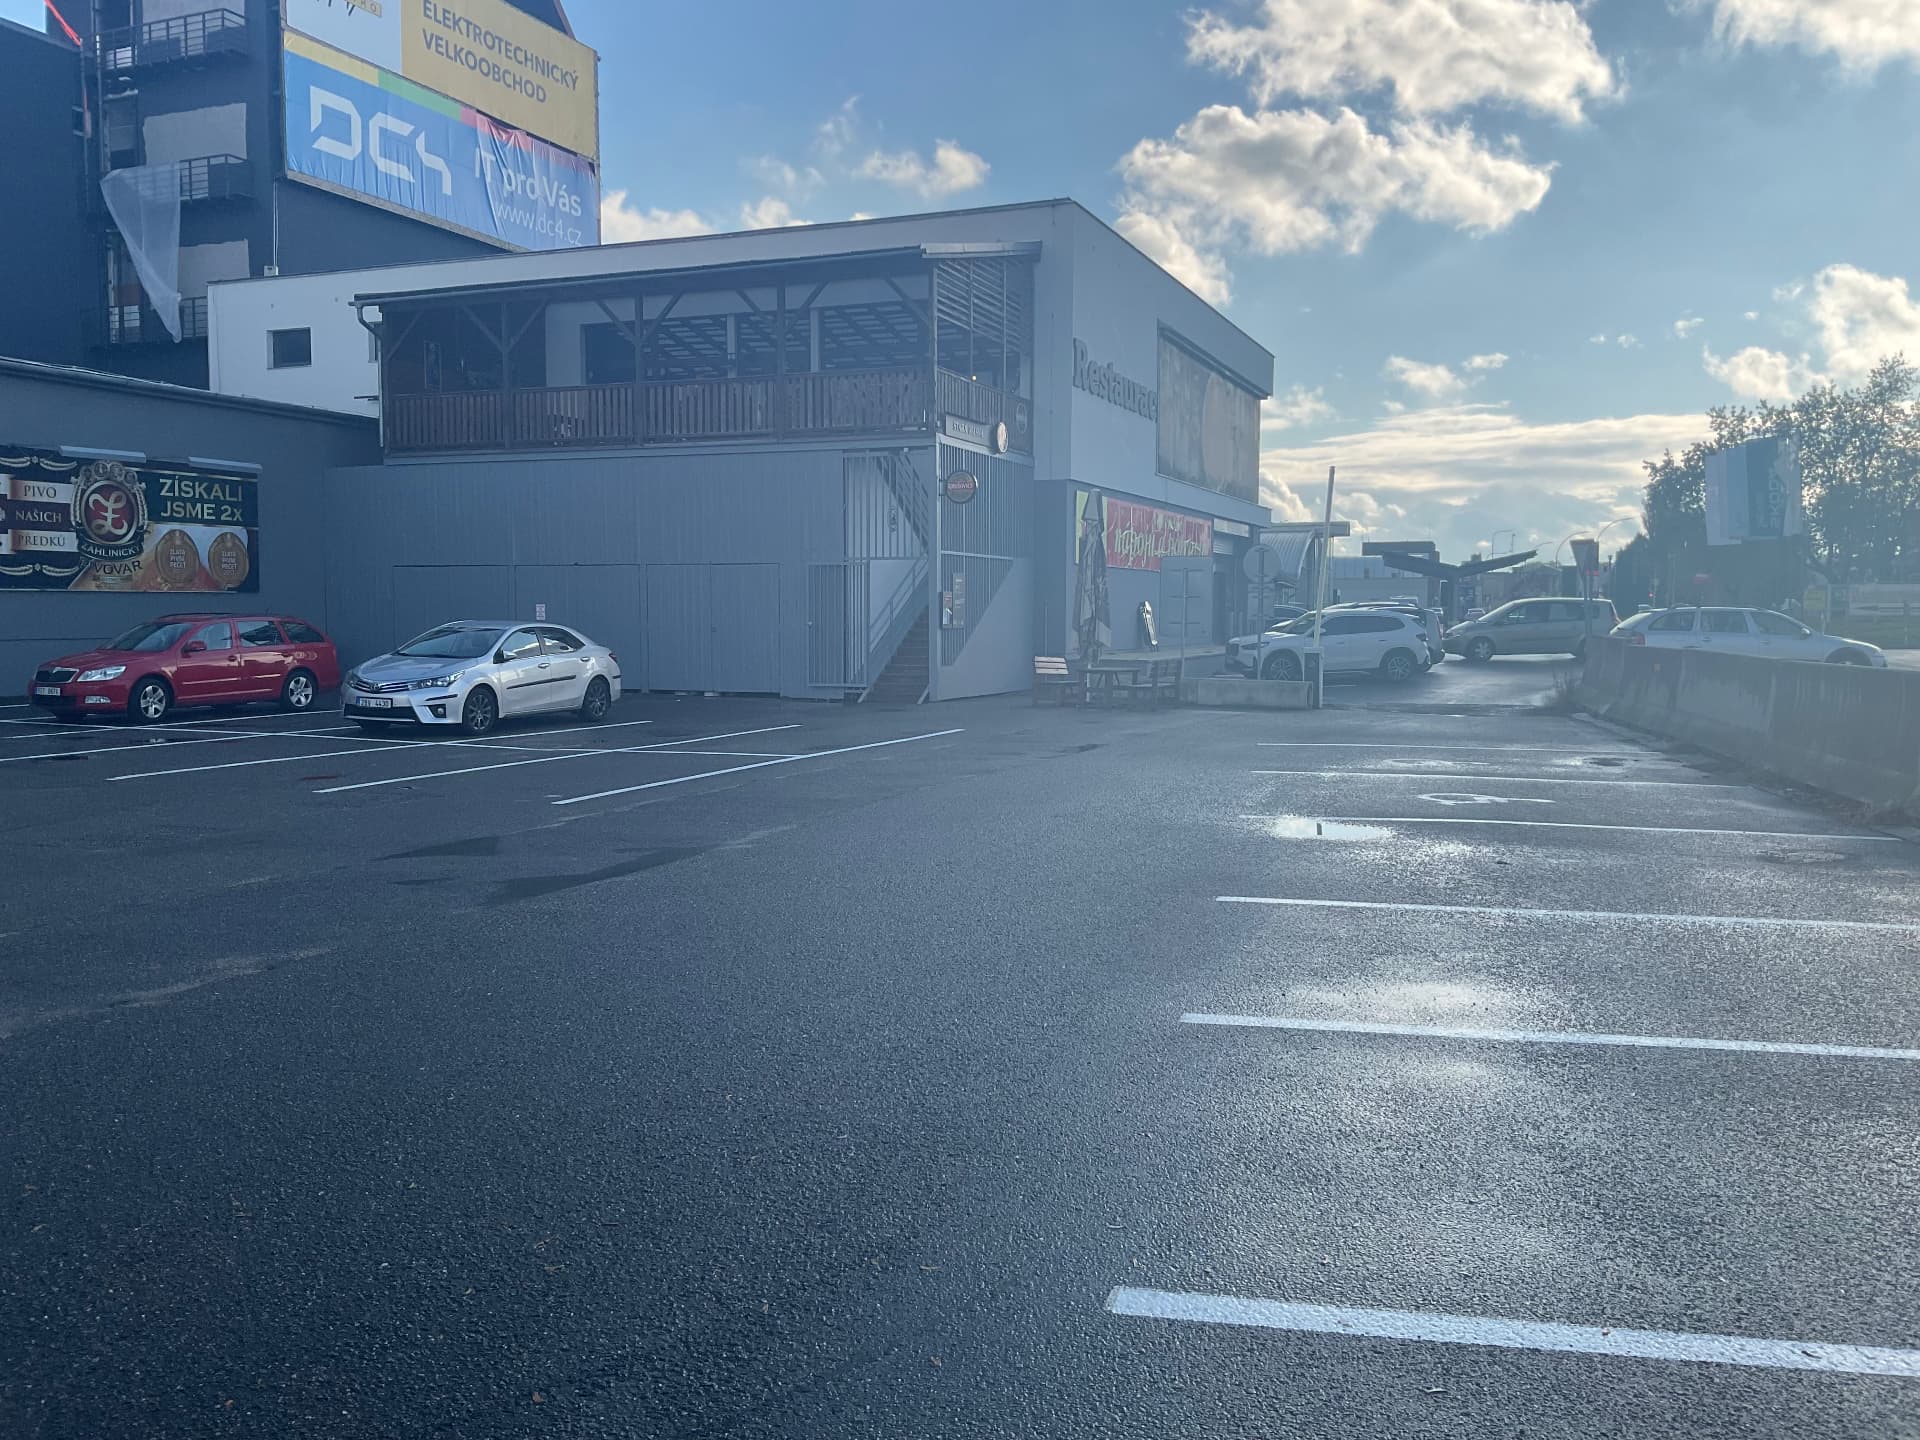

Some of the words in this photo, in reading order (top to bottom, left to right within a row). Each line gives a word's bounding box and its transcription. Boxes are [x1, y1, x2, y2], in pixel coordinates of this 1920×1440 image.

[423, 0, 578, 91] ELEKTROTECHNICKÝ
[422, 28, 547, 103] VELKOOBCHOD
[475, 147, 495, 183] IT
[543, 176, 581, 217] Vás
[496, 203, 581, 246] www.dc4.cz
[24, 485, 57, 499] PIVO
[160, 475, 243, 502] ZÍSKALI
[15, 509, 62, 523] NAŠICH
[161, 501, 216, 520] JSME
